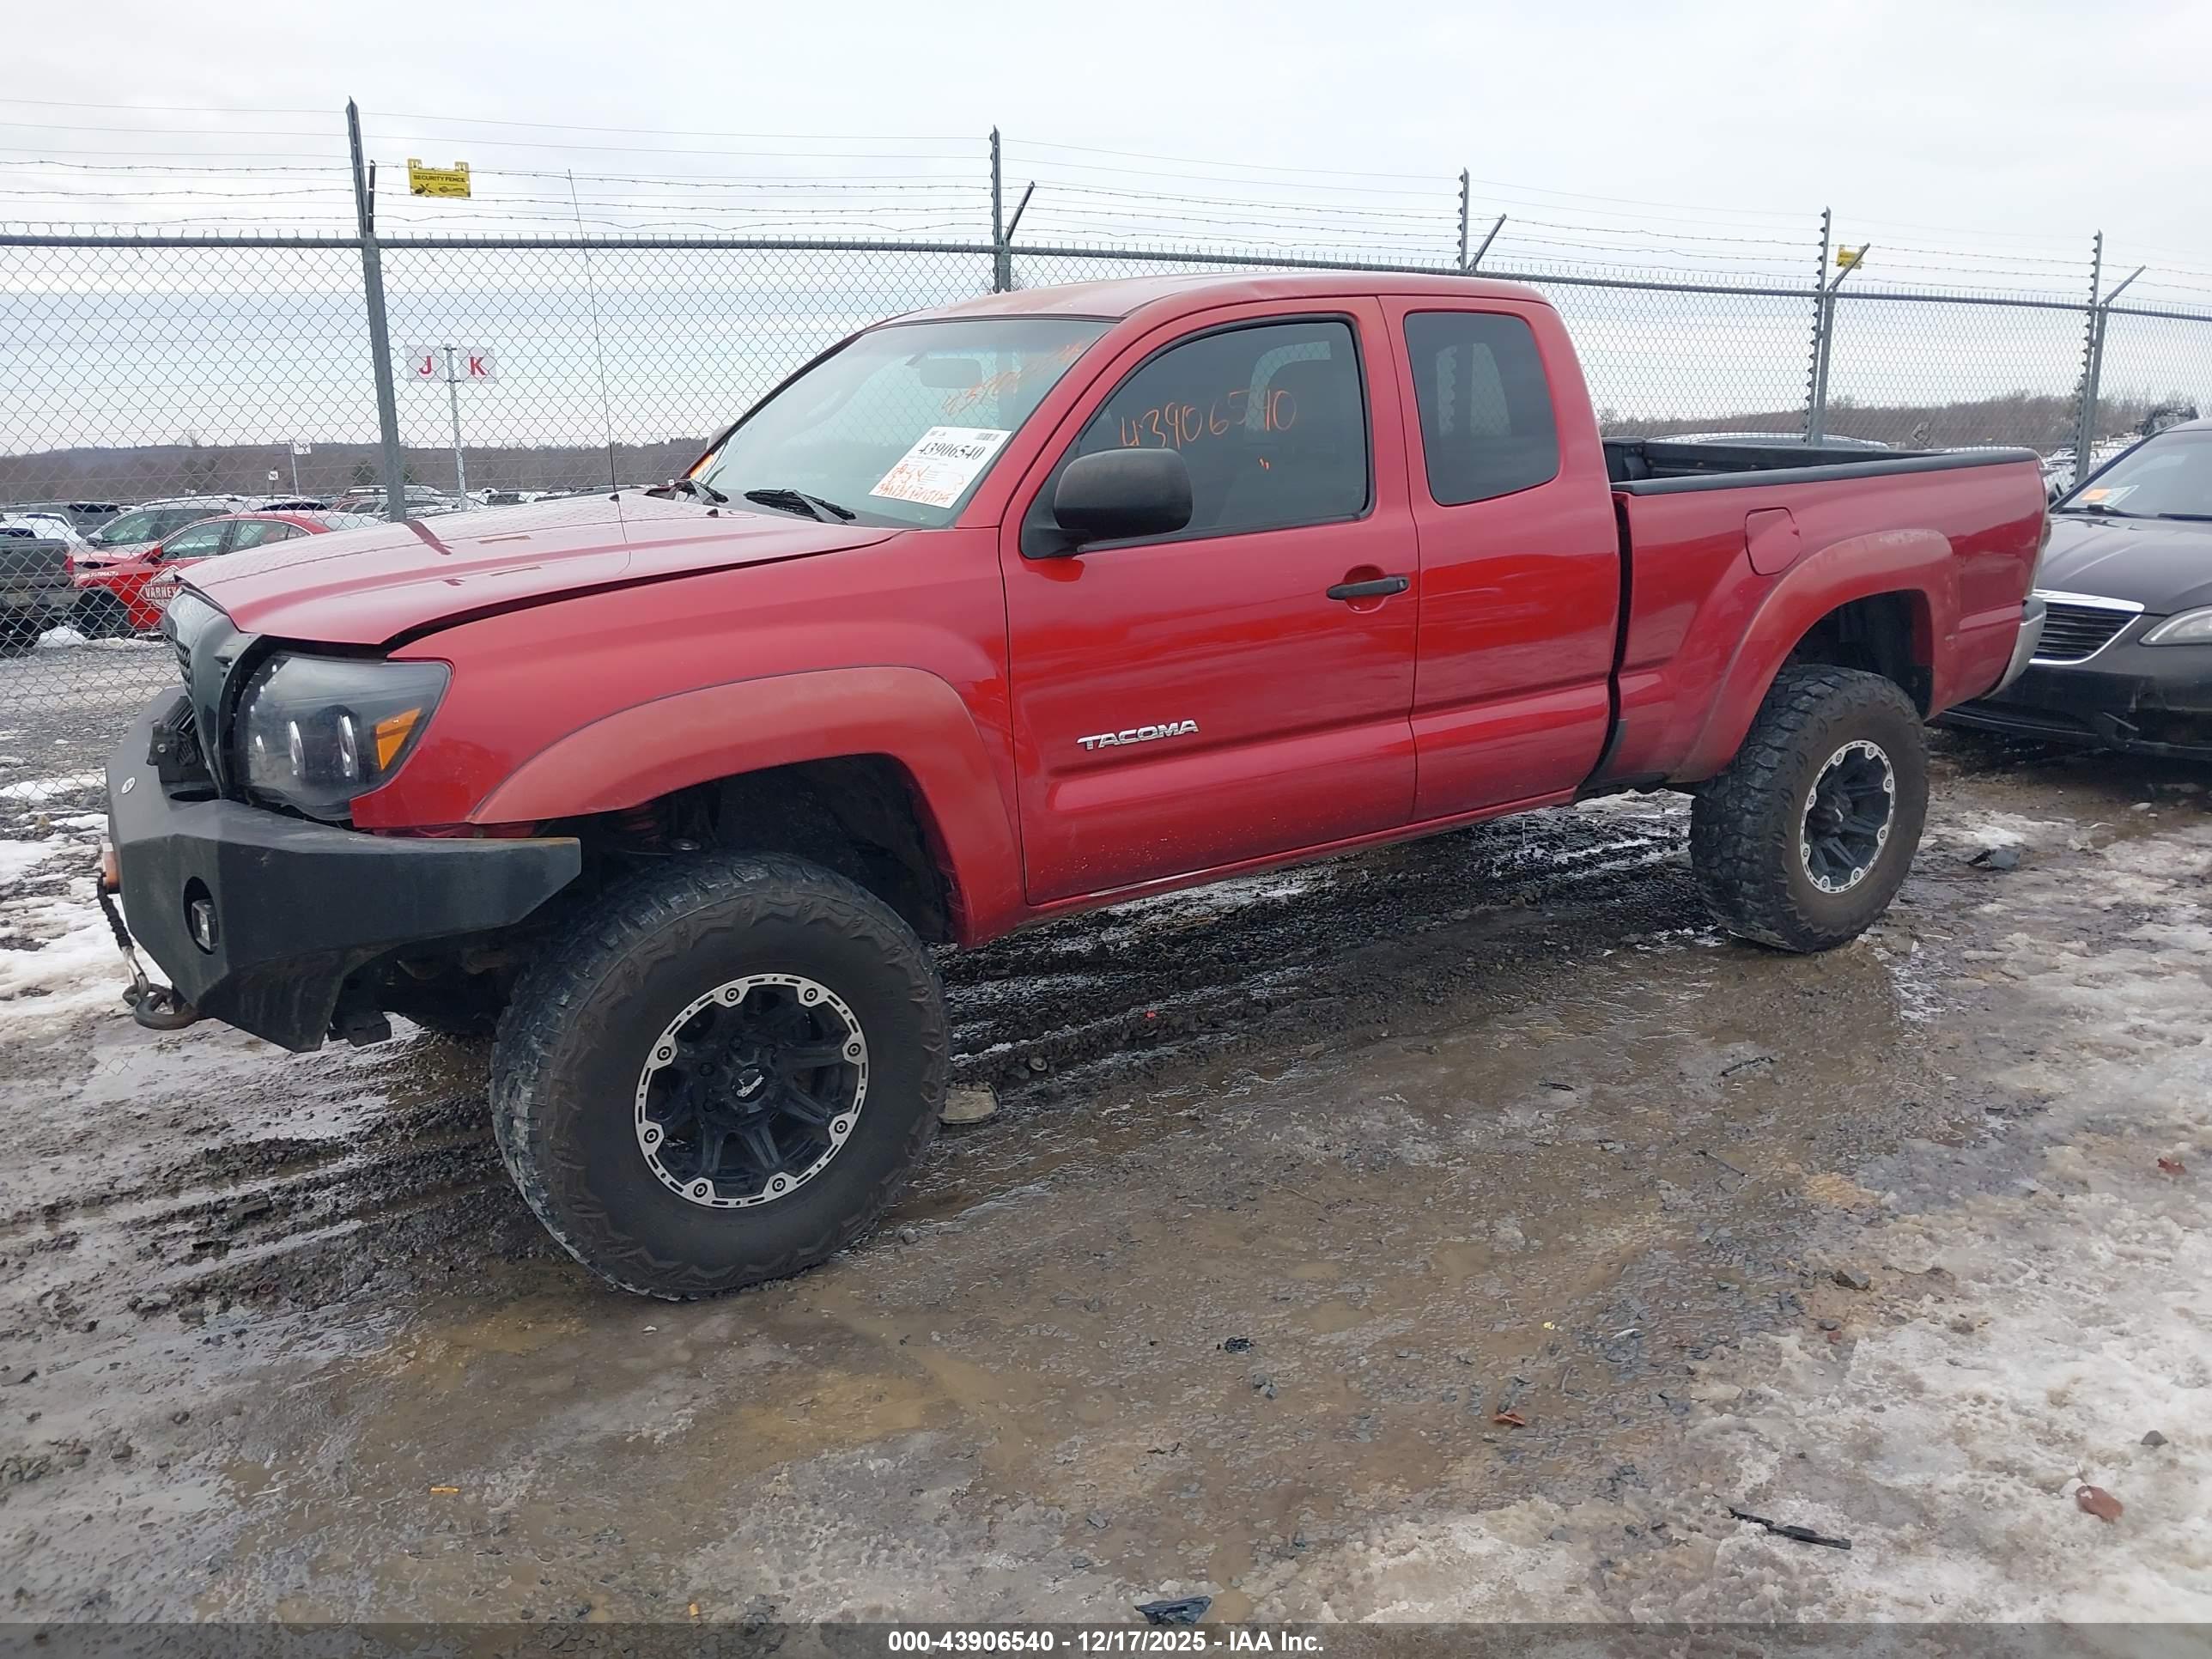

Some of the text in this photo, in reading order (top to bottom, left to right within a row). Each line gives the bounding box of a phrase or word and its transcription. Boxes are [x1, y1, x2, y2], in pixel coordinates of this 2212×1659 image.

[419, 356, 432, 375] J
[470, 356, 486, 375] K
[918, 441, 986, 460] 43906540
[1077, 720, 1200, 750] TACOMA
